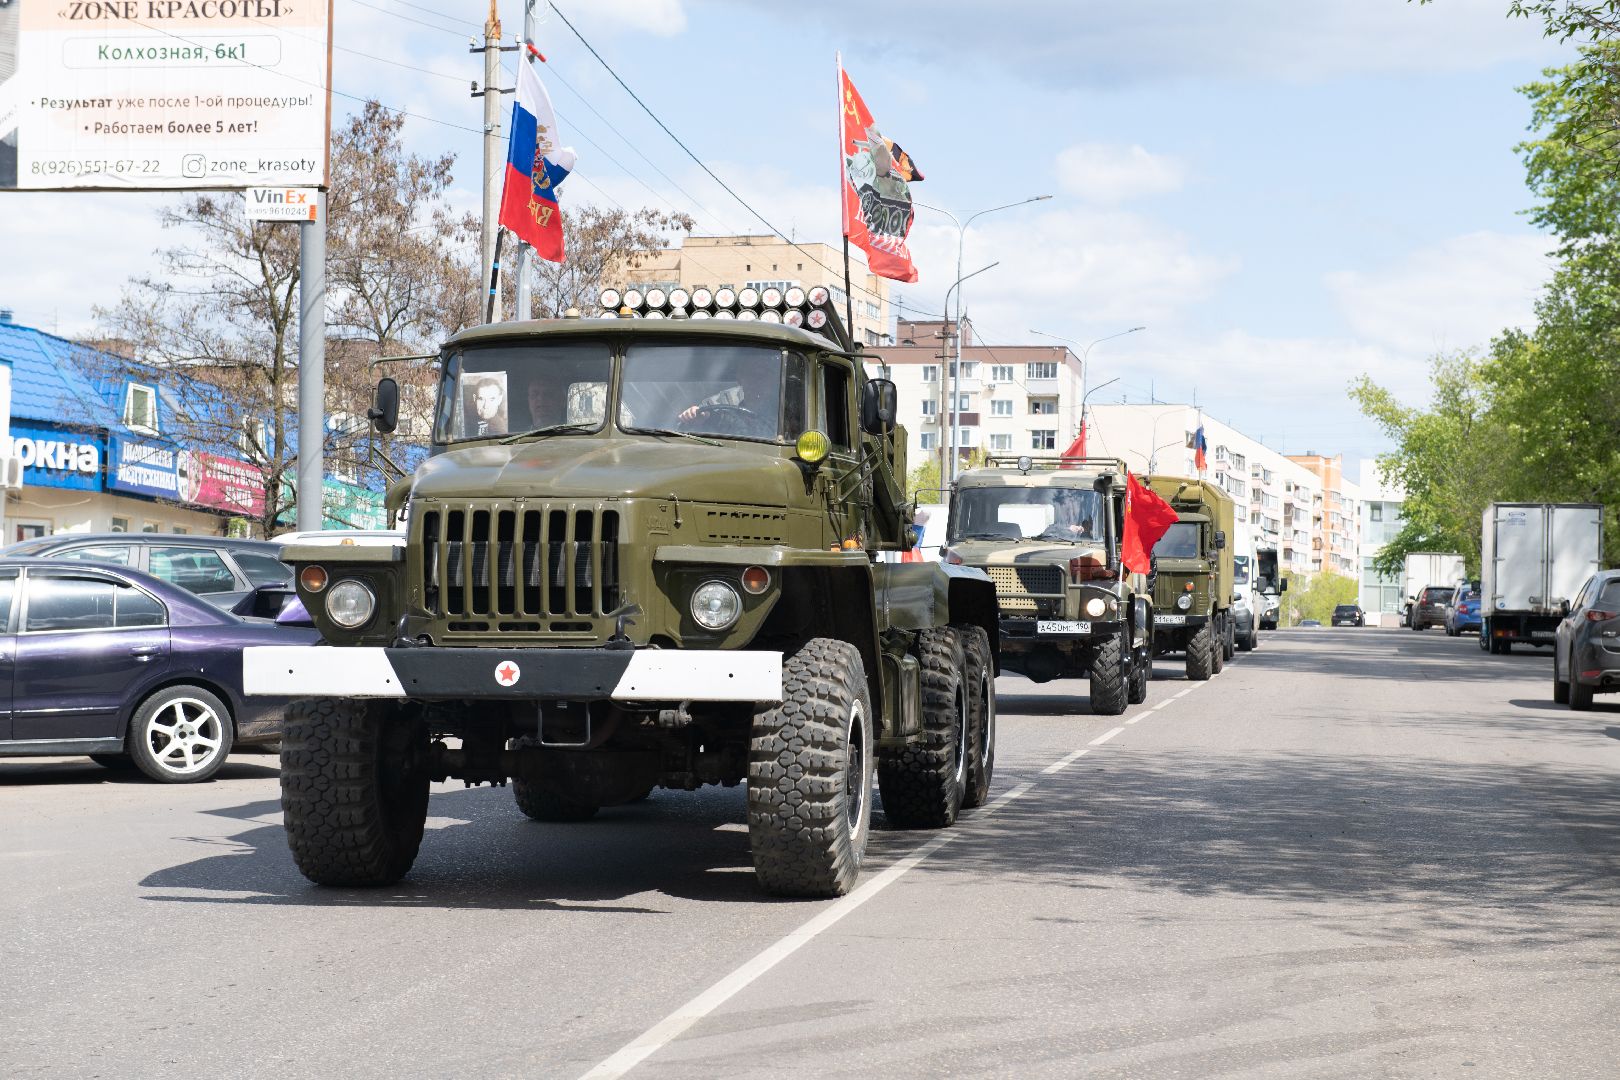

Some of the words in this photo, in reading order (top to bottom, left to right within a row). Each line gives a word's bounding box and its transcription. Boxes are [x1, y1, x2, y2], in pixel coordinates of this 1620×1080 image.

[98, 44, 209, 63] Колхозная,
[215, 43, 246, 60] 6к1
[41, 97, 113, 111] Результат
[117, 98, 145, 111] уже
[149, 97, 190, 108] после
[195, 95, 223, 108] 1-ой
[227, 95, 313, 109] процедуры!
[94, 121, 163, 134] Работаем
[168, 120, 212, 134] более
[215, 120, 223, 133] 5
[228, 120, 258, 133] лет!
[31, 160, 160, 175] 8(926)551-67-22
[211, 158, 316, 174] zone_krasoty
[253, 189, 306, 204] VinEx
[8, 436, 98, 473] окна
